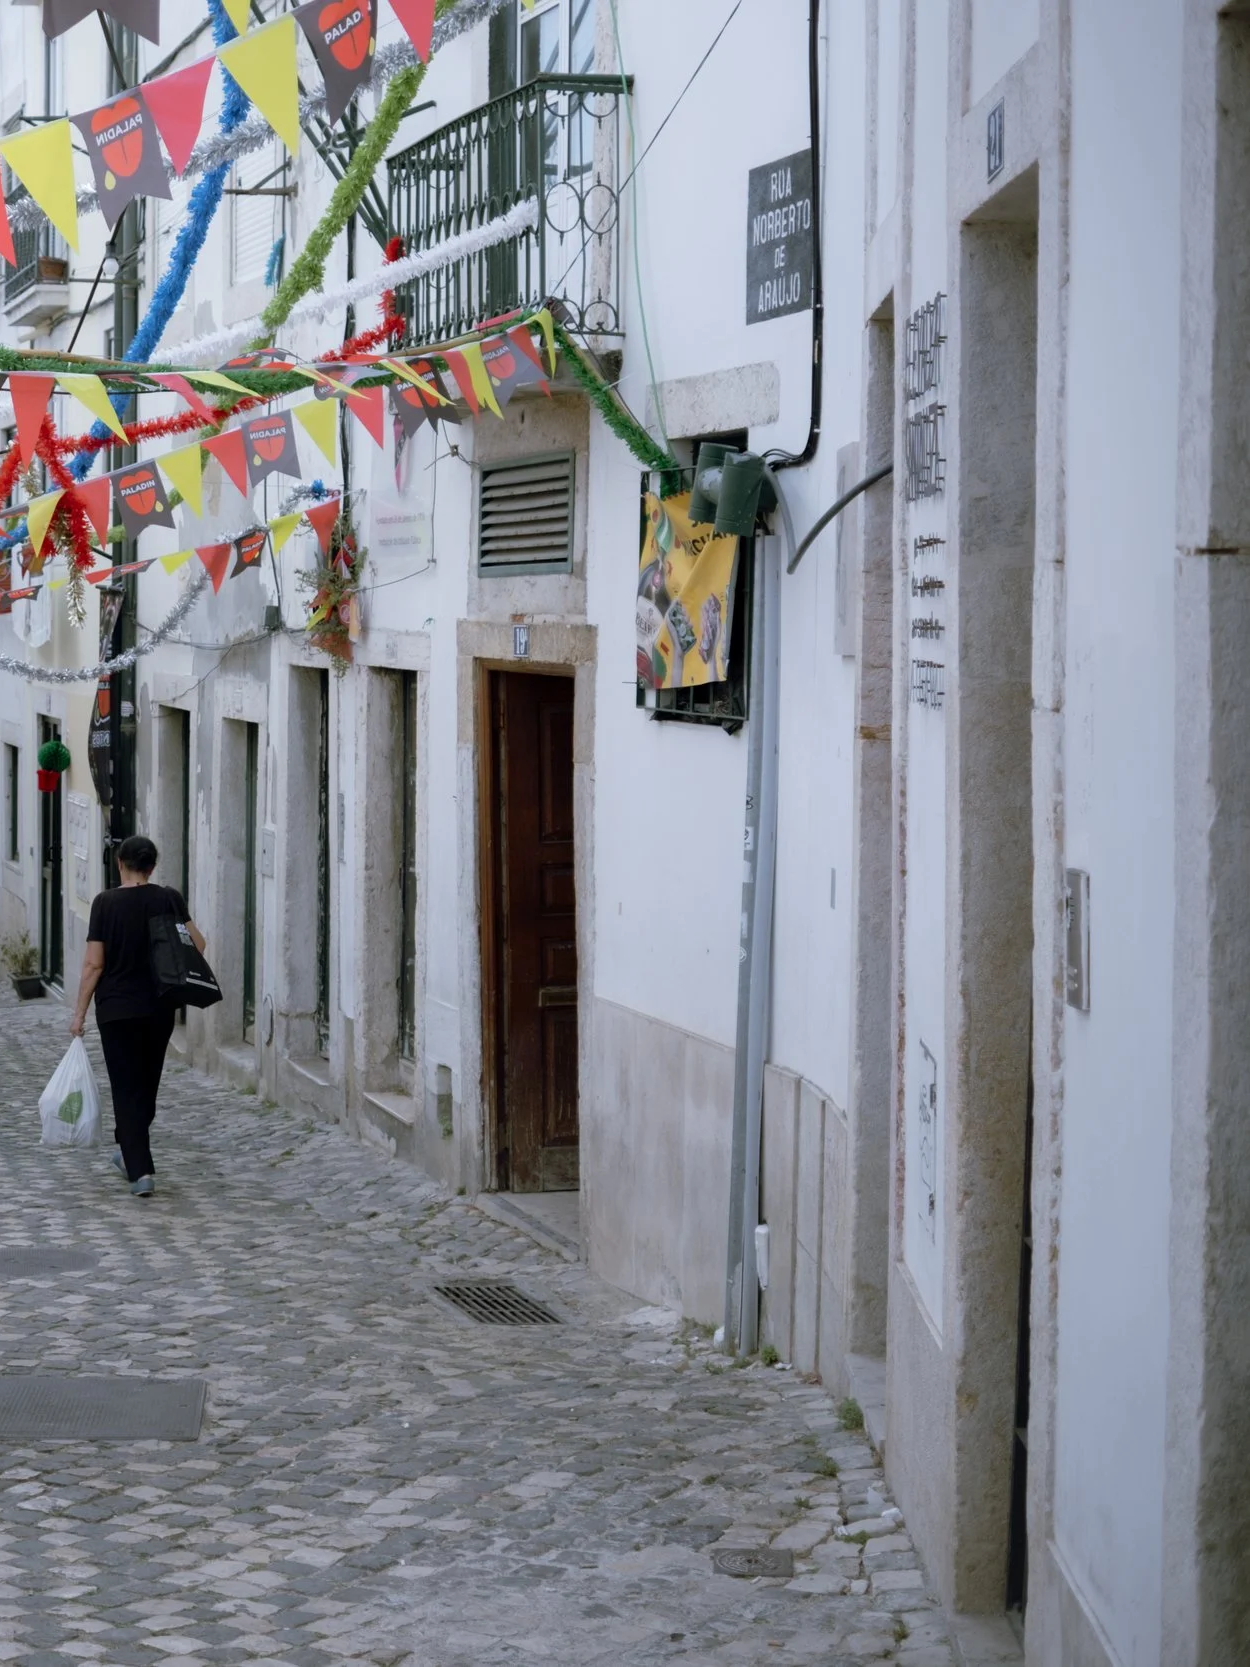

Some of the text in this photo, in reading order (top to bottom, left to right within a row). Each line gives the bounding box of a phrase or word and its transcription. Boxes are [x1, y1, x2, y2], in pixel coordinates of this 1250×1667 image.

[324, 10, 362, 45] PALAD
[770, 167, 792, 202] RUA
[753, 198, 811, 247] NORBERTO
[774, 245, 785, 268] DE
[758, 270, 800, 313] ARAÚJO
[121, 480, 155, 496] PALADIN
